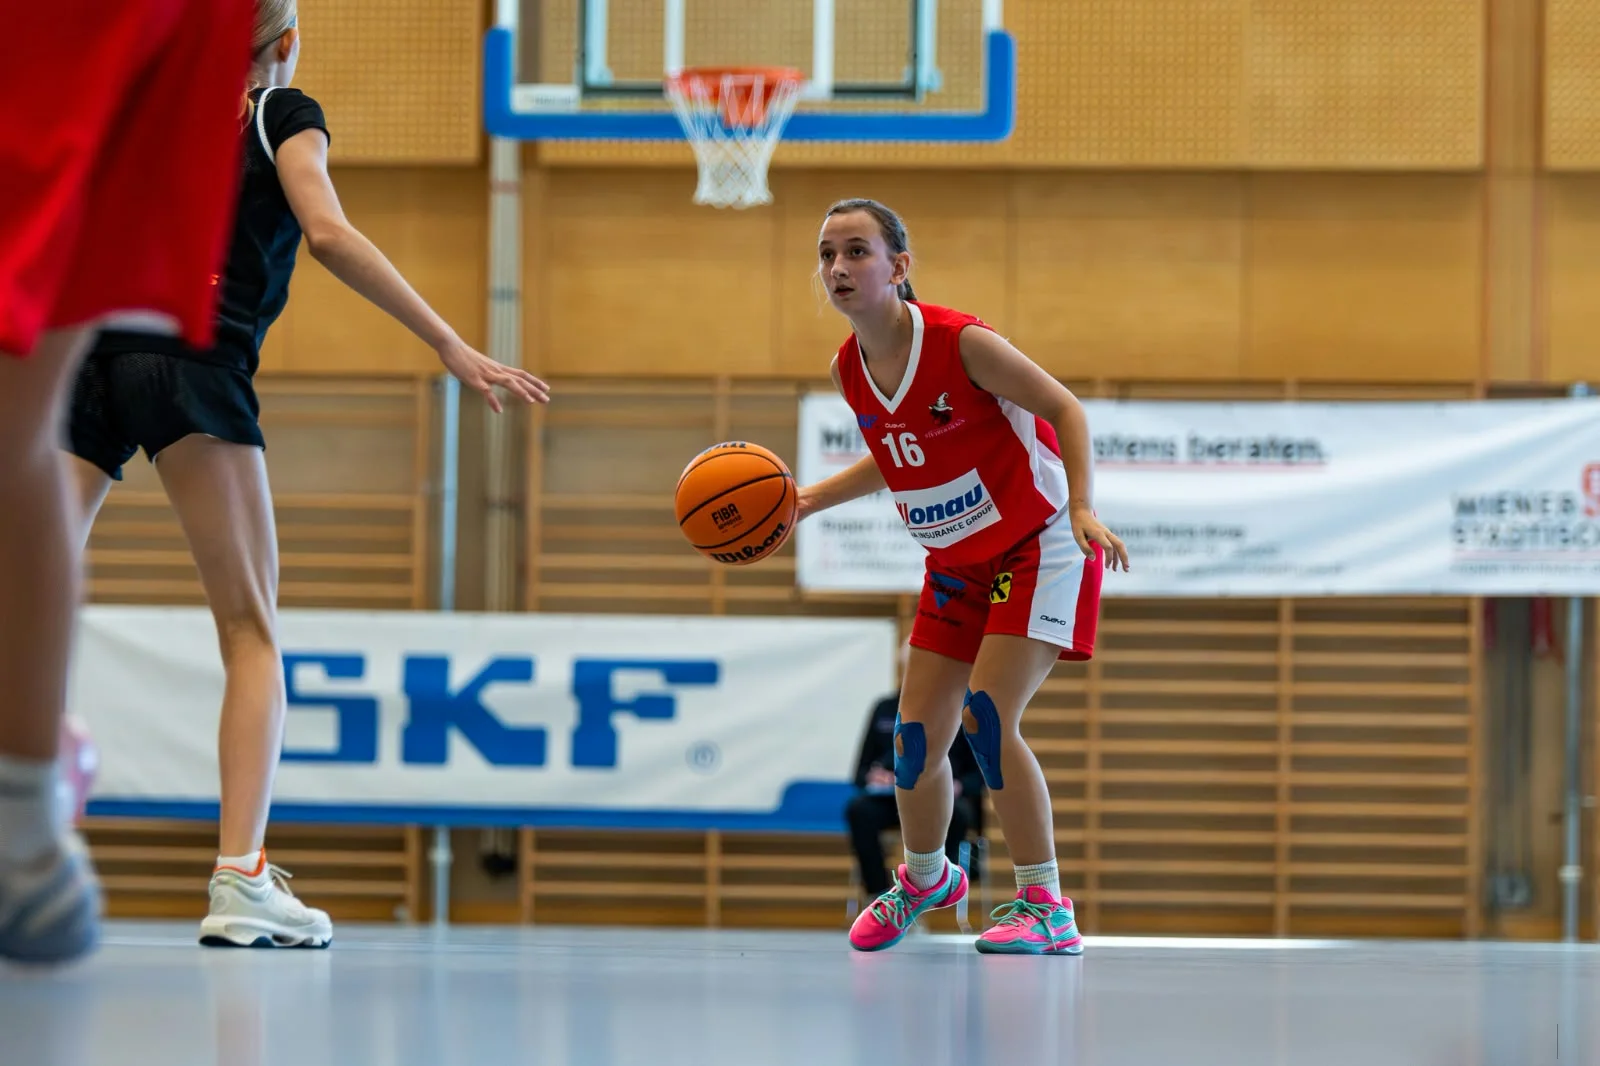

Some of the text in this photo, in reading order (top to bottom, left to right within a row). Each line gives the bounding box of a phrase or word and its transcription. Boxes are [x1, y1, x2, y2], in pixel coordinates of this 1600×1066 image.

[881, 432, 926, 468] 16
[711, 503, 739, 525] FIBA
[919, 521, 965, 539] INSURANCE
[966, 503, 993, 526] GROUP
[710, 522, 786, 563] Wilson
[279, 654, 719, 768] SKF
